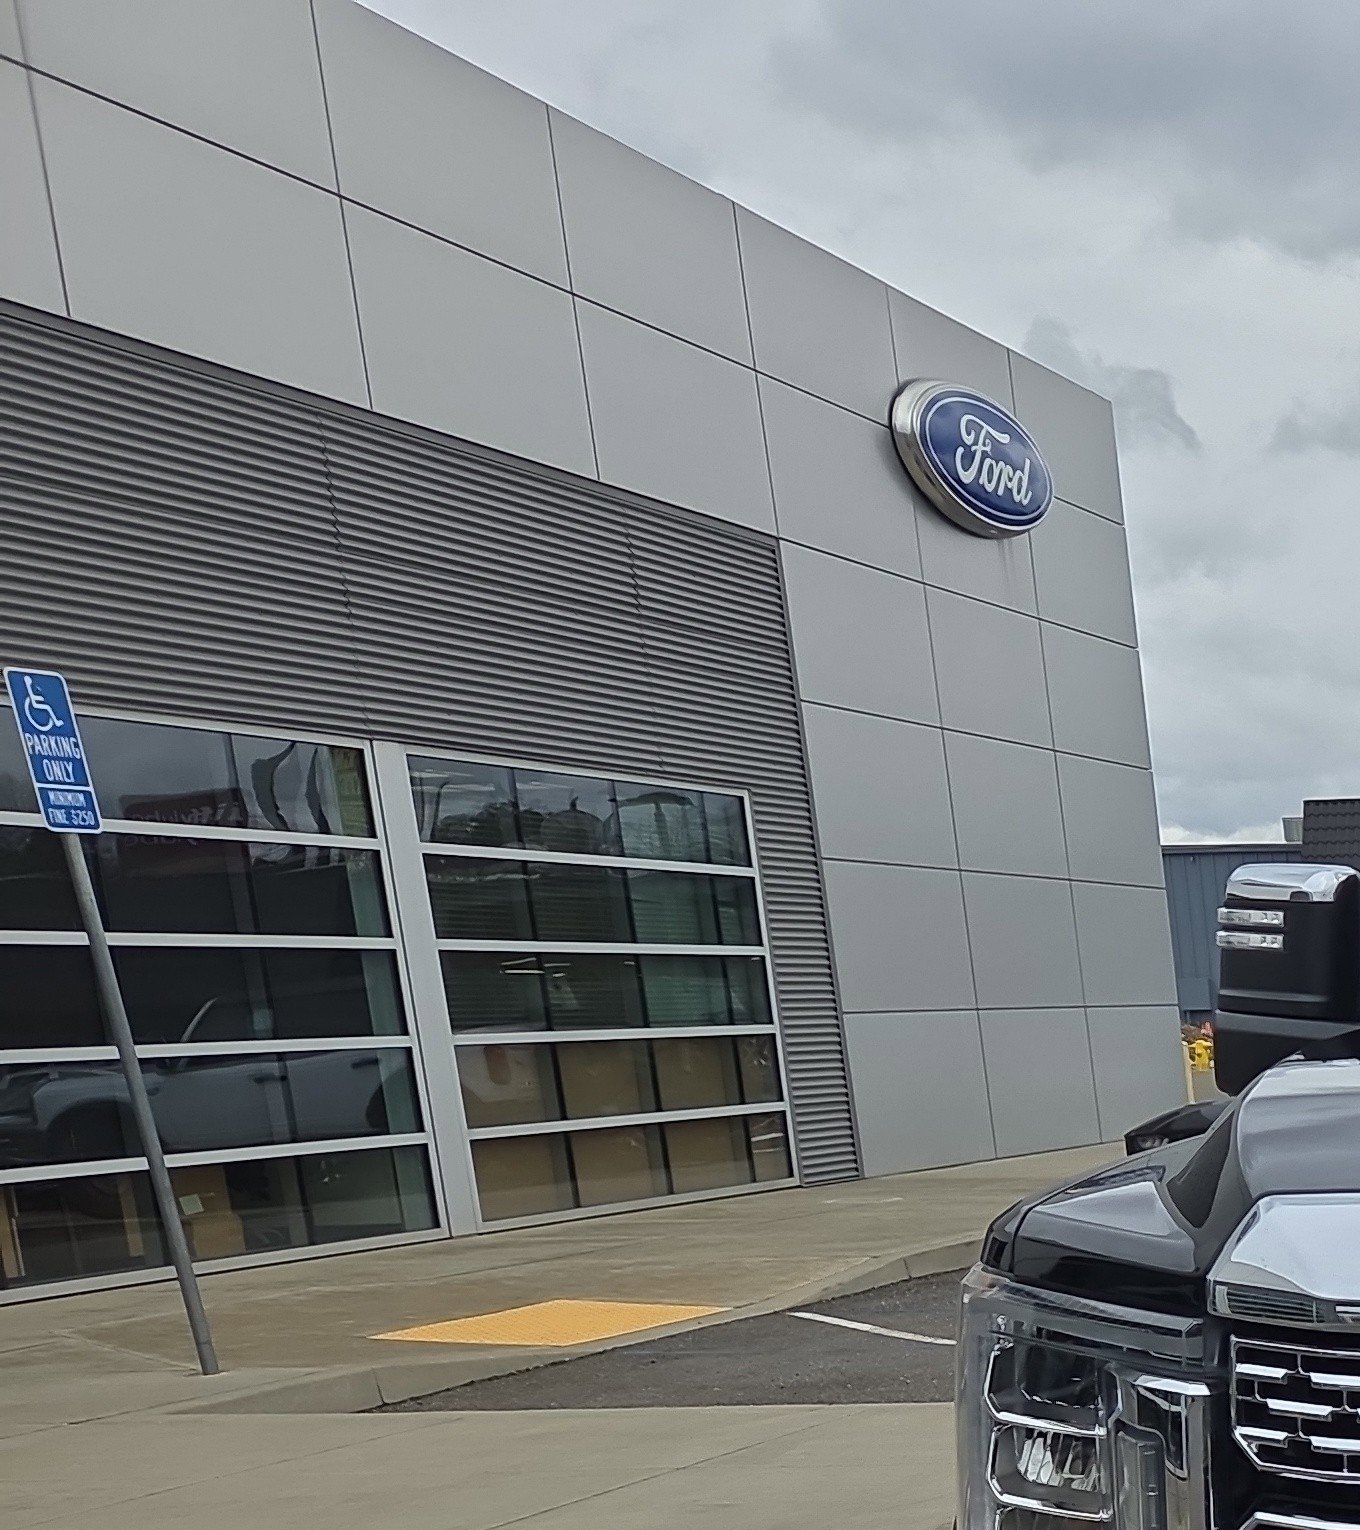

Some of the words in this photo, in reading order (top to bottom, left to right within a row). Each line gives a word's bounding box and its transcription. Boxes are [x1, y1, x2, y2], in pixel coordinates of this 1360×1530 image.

[954, 413, 1033, 507] Ford
[25, 733, 81, 759] PARKING
[42, 759, 75, 783] ONLY
[48, 808, 70, 825] FINE
